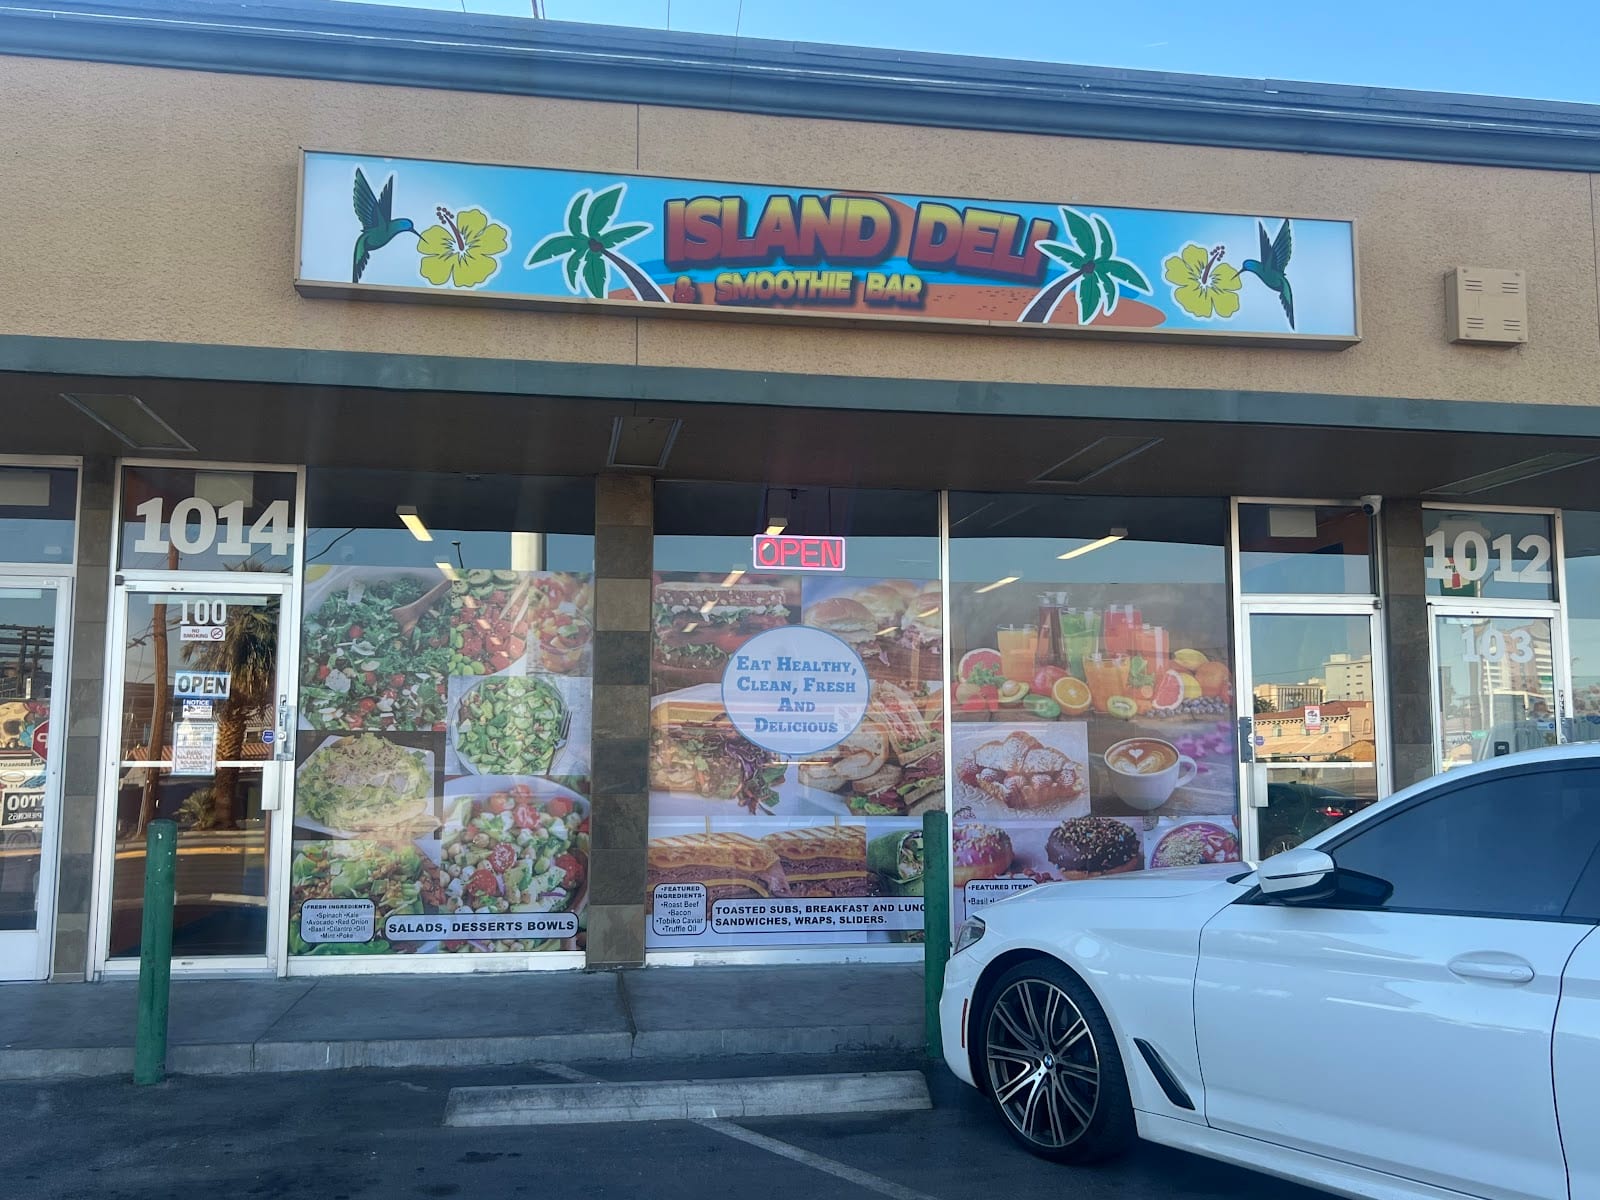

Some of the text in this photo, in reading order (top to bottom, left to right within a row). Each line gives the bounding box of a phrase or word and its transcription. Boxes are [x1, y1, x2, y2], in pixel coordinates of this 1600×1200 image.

[664, 194, 1055, 282] ISLAND DELI
[674, 270, 926, 304] & SMOOTHIE BAR
[134, 497, 295, 556] 1014
[758, 538, 842, 568] OPEN
[1425, 530, 1552, 584] 1012
[179, 599, 228, 625] 100
[1462, 629, 1534, 664] 103
[736, 655, 857, 677] EAT HEALTHY,
[177, 674, 228, 695] OPEN
[737, 676, 856, 695] CLEAN, FRESH
[777, 697, 816, 712] AND
[754, 717, 838, 733] DELICIOUS
[715, 904, 925, 915] TOASTED SUBS, BREAKFAST AND LUNC
[388, 920, 575, 934] SALADS, DESSERTS BOWLS
[715, 915, 888, 927] SANDWICHES, WRAPS, SLIDERS.
